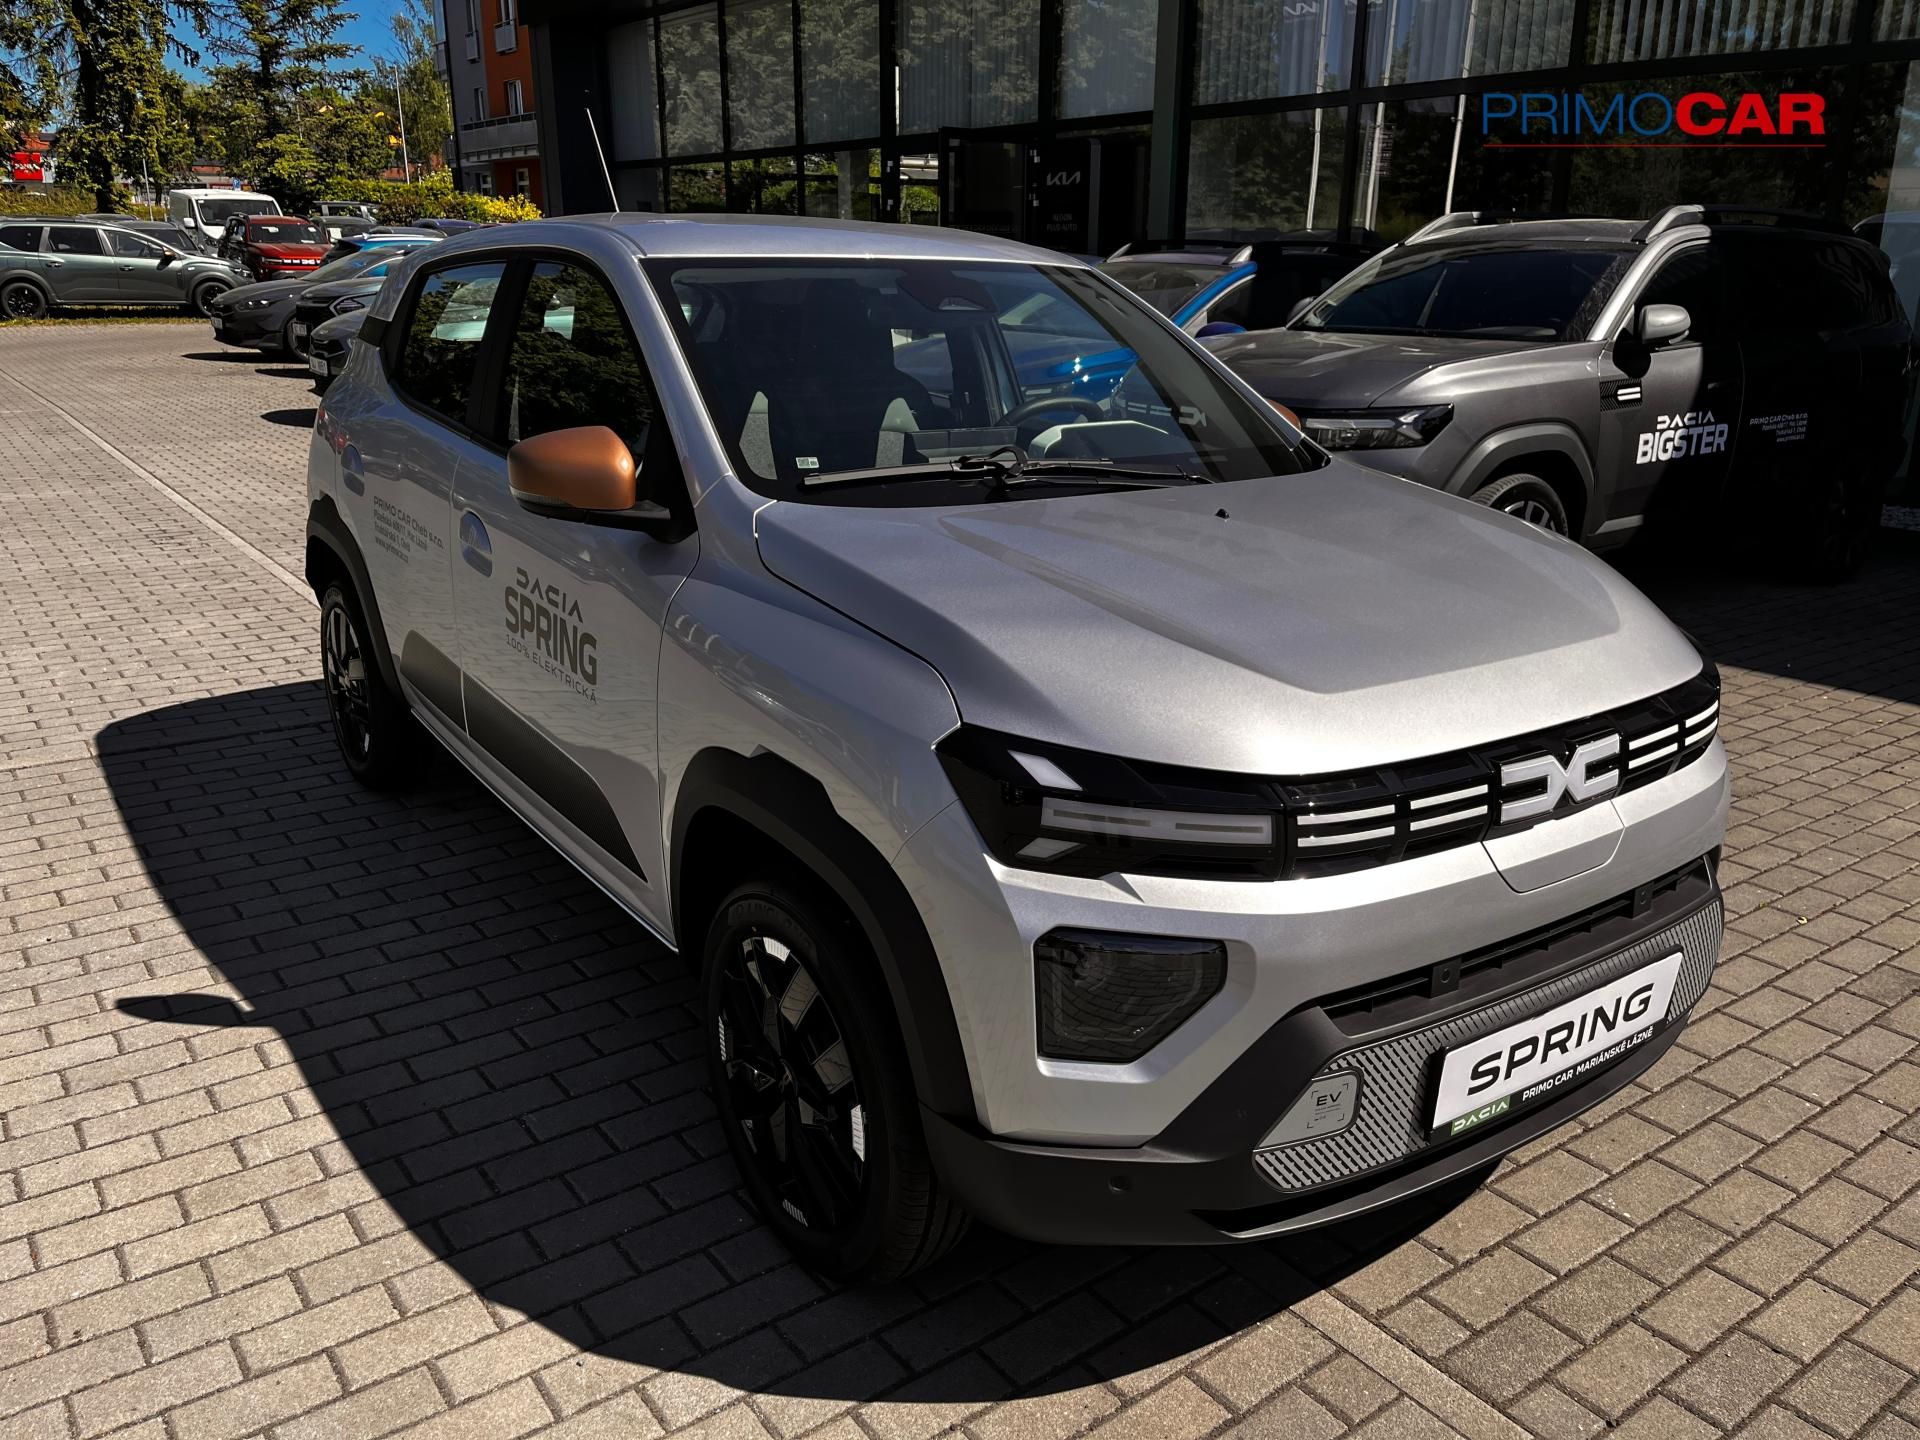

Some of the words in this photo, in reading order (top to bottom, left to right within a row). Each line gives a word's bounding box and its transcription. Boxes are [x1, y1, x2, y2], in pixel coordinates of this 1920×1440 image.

[1046, 171, 1081, 186] KIA
[1656, 411, 1715, 430] DACIA
[1636, 423, 1728, 464] BIGSTER
[374, 496, 397, 517] PRIMO
[397, 509, 412, 527] CAR
[412, 519, 428, 538] Cheb
[516, 566, 583, 623] DACIA
[505, 586, 597, 685] SPRING
[506, 633, 530, 658] 100%
[532, 651, 597, 704] ELEKTRICKÁ
[1467, 983, 1655, 1097] SPRING
[1522, 1079, 1554, 1102] PRIMO
[1554, 1070, 1574, 1086] CAR
[1576, 1040, 1627, 1076] MARIÁNSKÉ
[1626, 1025, 1654, 1049] LÁZNĚ
[1316, 1091, 1342, 1107] EV
[1453, 1101, 1509, 1132] DACIA
